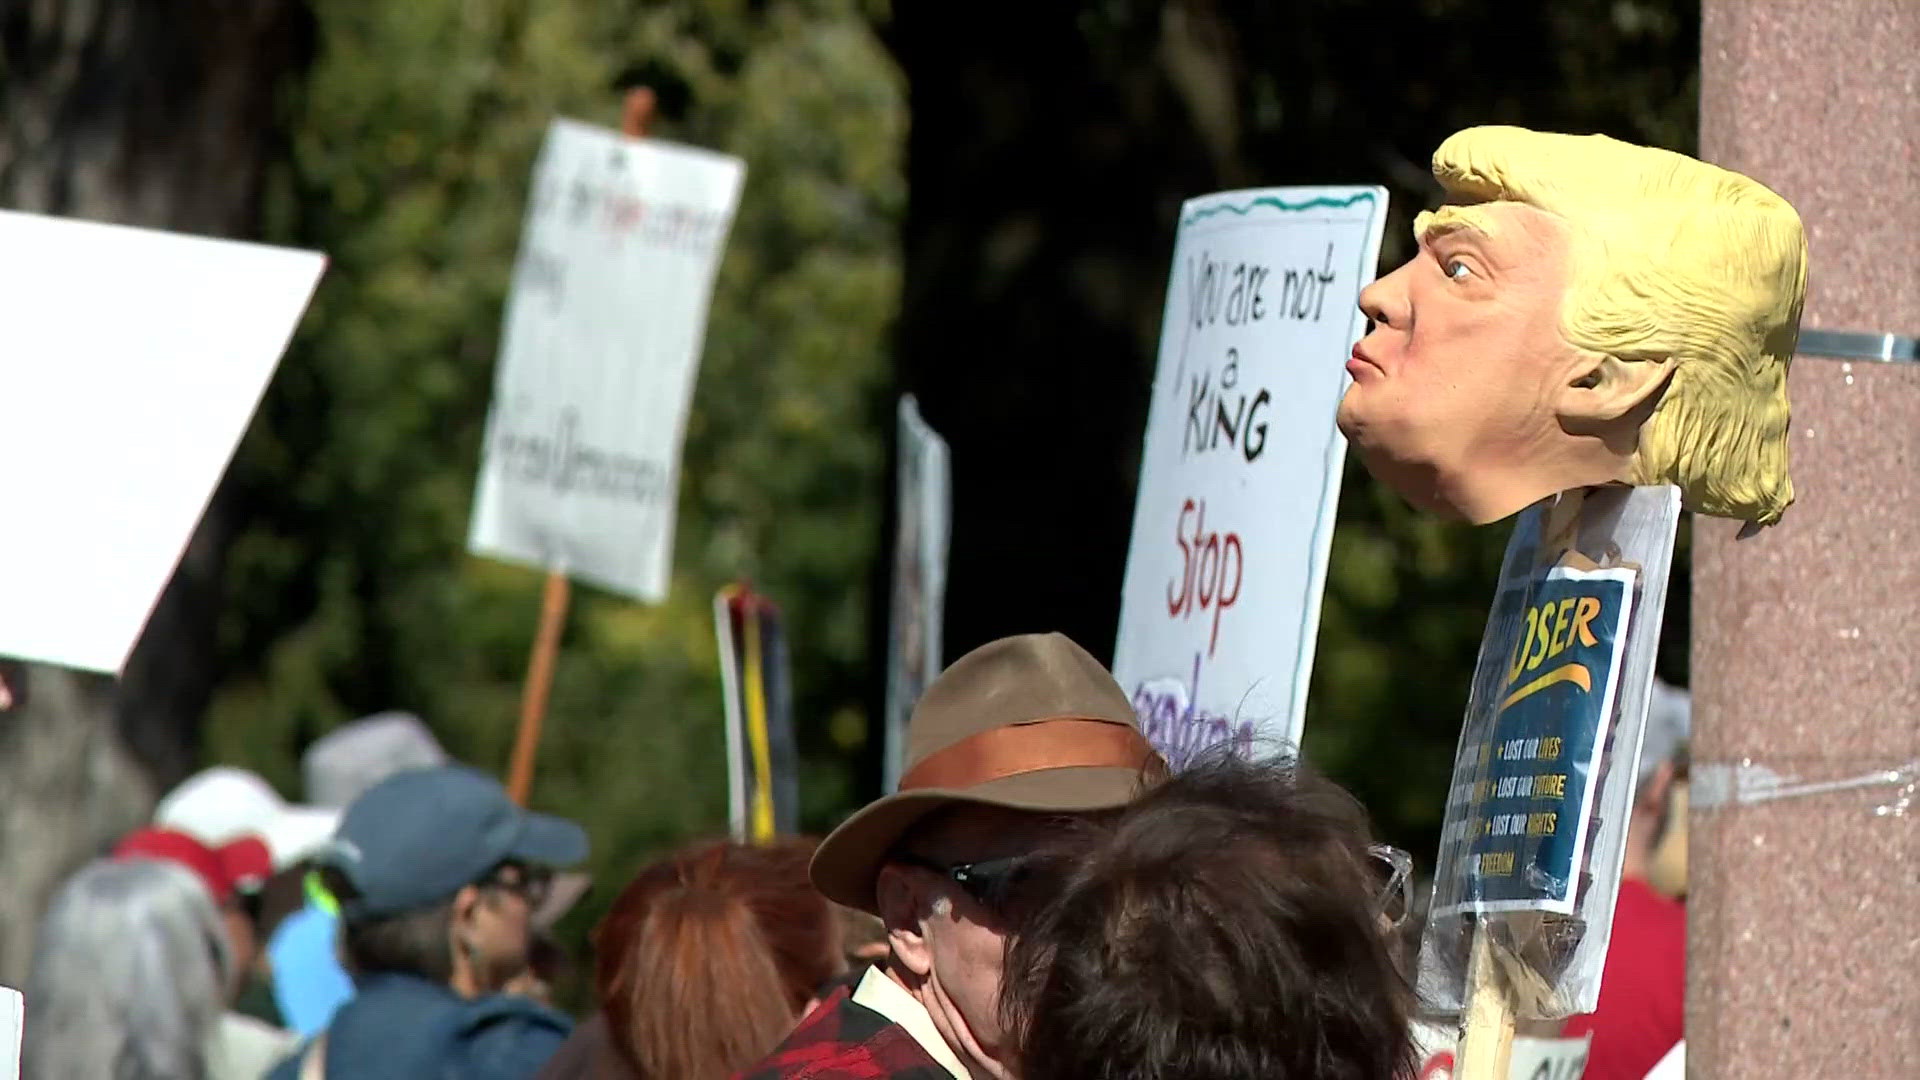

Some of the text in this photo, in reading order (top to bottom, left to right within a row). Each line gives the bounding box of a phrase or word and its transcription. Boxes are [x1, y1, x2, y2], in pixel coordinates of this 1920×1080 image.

[1175, 242, 1336, 397] You are not
[1220, 347, 1240, 389] a
[1182, 369, 1272, 463] KING
[1167, 498, 1244, 660] Stop
[1508, 596, 1601, 686] OSER
[1503, 739, 1526, 760] LOST
[1523, 737, 1540, 760] OUR
[1538, 735, 1562, 761] LIVES
[1497, 776, 1519, 799] LOST
[1516, 775, 1534, 797] OUR
[1531, 774, 1567, 799] FUTURE
[1491, 814, 1512, 836] LOST
[1510, 813, 1528, 835] OUR
[1526, 812, 1558, 837] RIGHTS
[1480, 852, 1515, 876] FREEDOM
